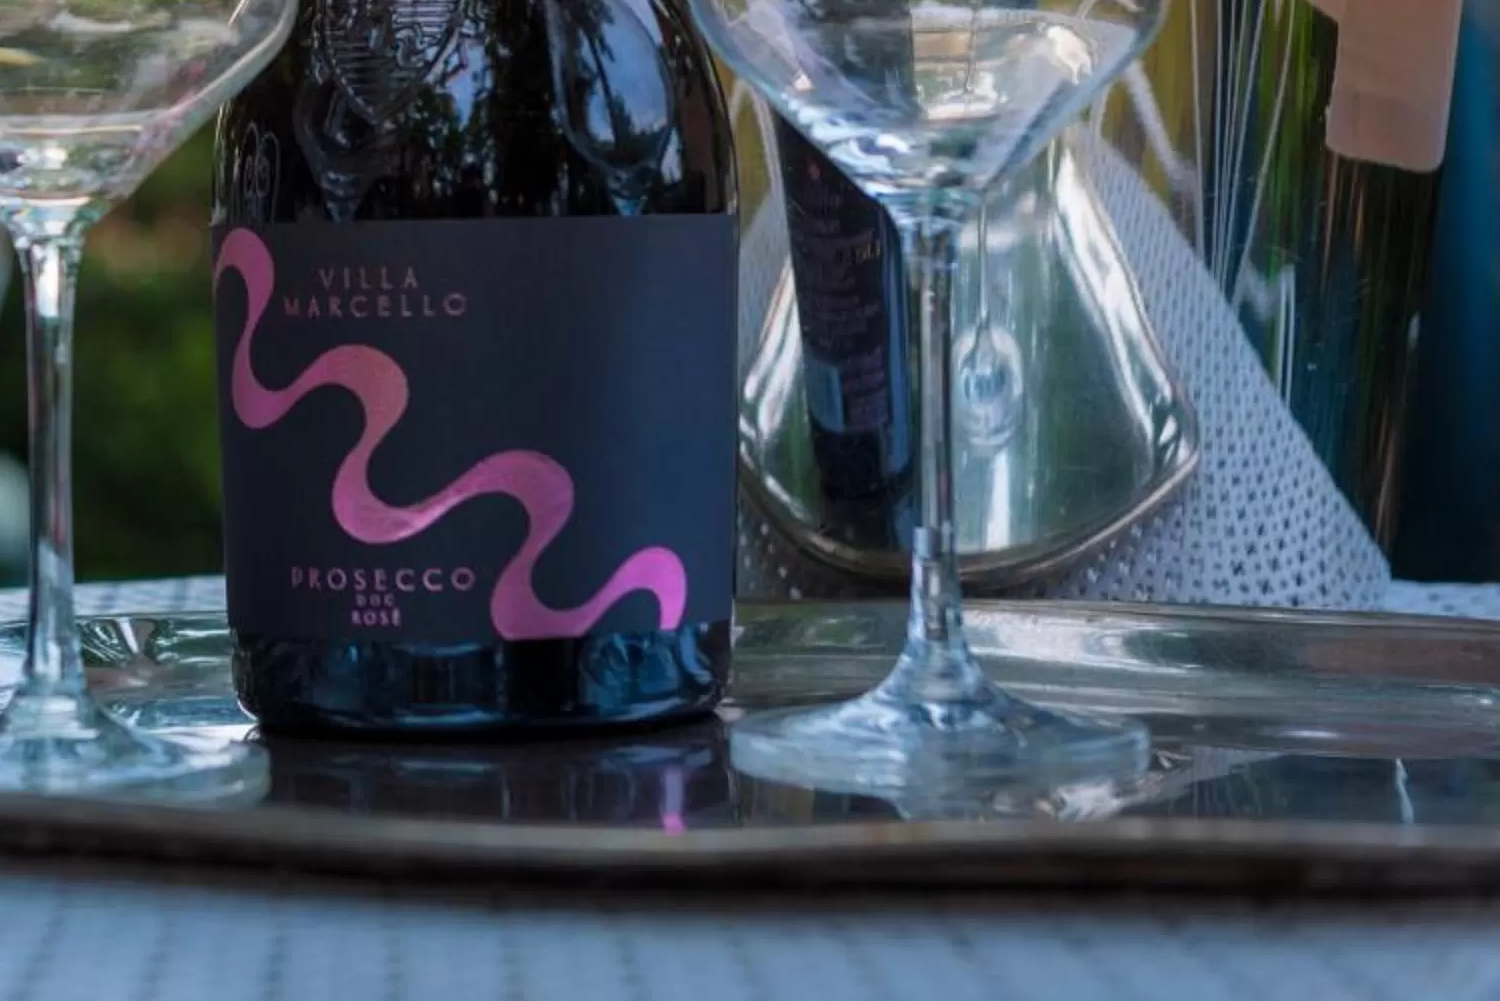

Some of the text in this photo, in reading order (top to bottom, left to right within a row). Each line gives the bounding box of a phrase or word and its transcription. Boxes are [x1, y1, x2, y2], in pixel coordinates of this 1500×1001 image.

[319, 266, 418, 290] VILLA
[283, 293, 467, 318] MARCELLO
[291, 567, 476, 591] PROSECCO
